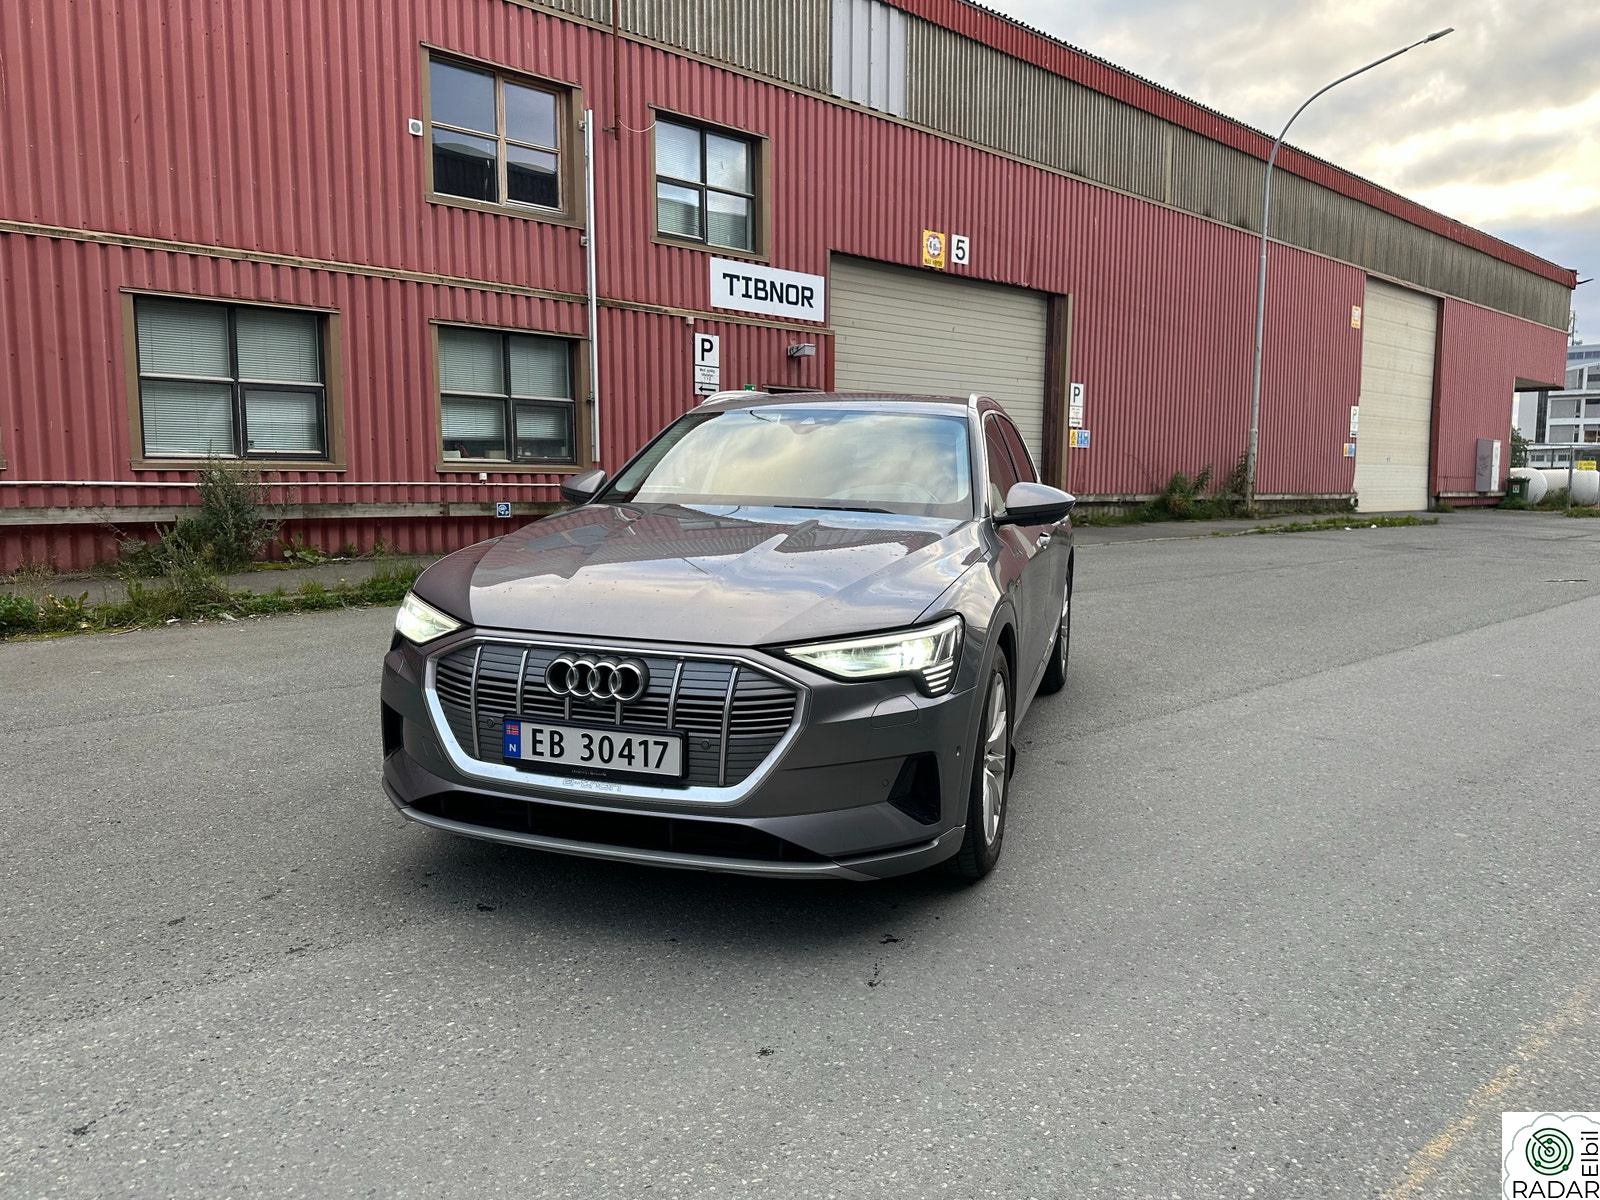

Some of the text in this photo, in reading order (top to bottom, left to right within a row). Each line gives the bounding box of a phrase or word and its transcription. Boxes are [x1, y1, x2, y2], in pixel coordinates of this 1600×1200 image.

[956, 239, 965, 260] 5
[722, 272, 814, 308] TIBNOR
[701, 338, 713, 361] P
[1073, 386, 1080, 403] P
[1352, 408, 1357, 420] P
[509, 743, 516, 752] N
[531, 728, 669, 768] EB 30417
